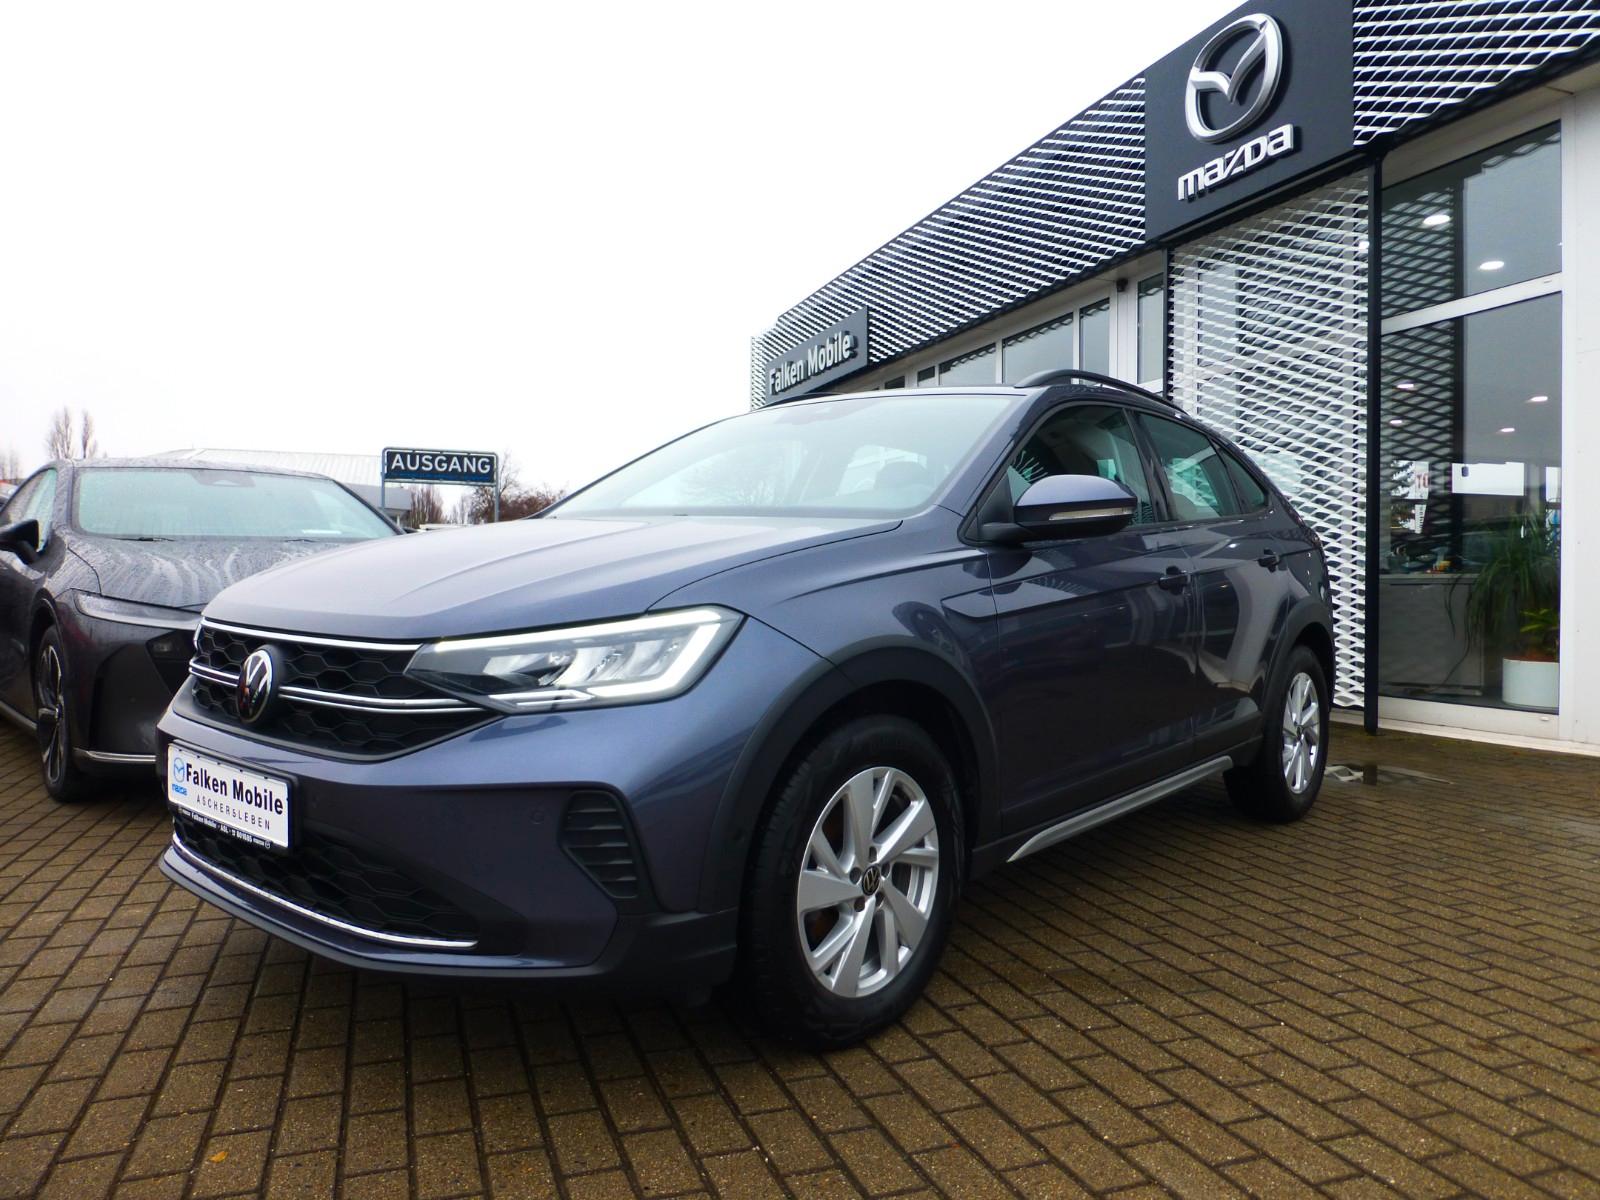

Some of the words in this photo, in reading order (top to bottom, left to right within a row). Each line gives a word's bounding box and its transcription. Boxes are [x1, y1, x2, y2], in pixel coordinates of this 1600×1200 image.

[1178, 124, 1294, 200] mazda
[769, 359, 805, 394] Falken
[807, 331, 852, 376] Mobile
[391, 453, 491, 474] AUSGANG
[186, 763, 227, 795] Falken
[232, 779, 283, 815] Mobile
[196, 795, 270, 830] ASCHERSLEBEN
